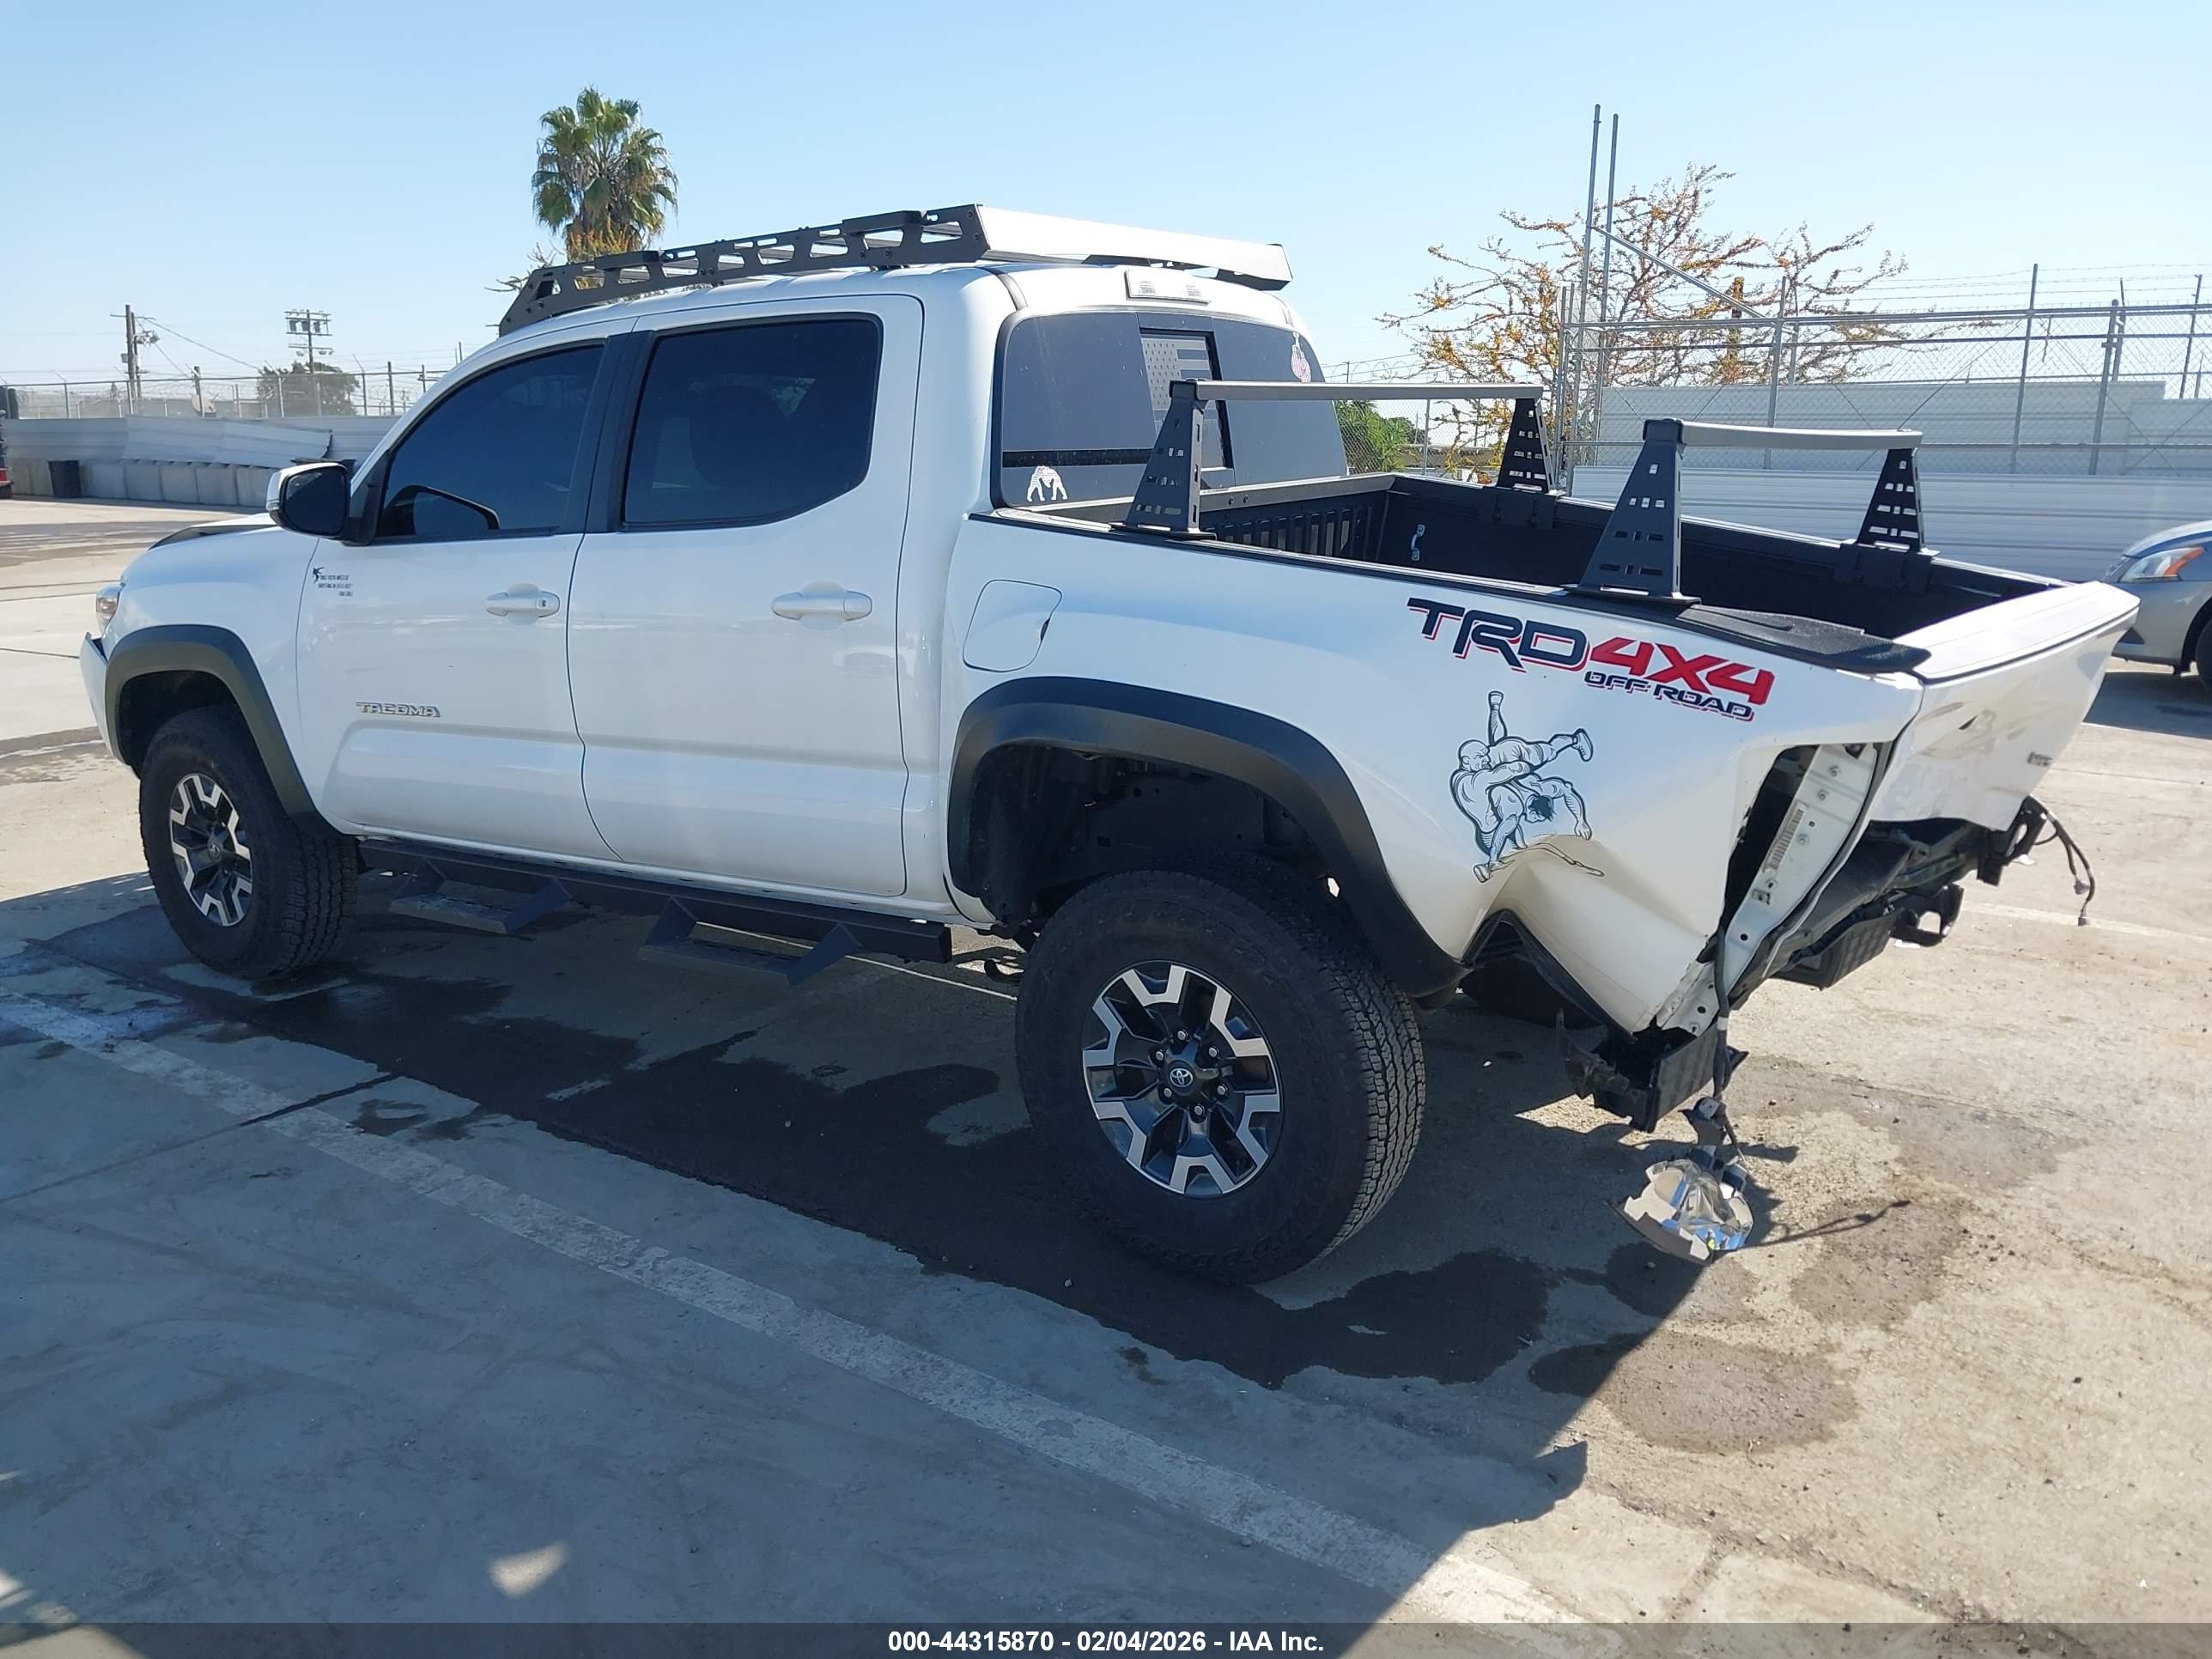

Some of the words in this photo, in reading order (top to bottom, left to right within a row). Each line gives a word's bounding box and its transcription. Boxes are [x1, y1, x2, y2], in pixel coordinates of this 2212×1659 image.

[1407, 598, 1590, 672] TRD
[356, 702, 440, 717] TACOMA
[1584, 671, 1651, 693] OFF
[1652, 684, 1754, 721] ROAD
